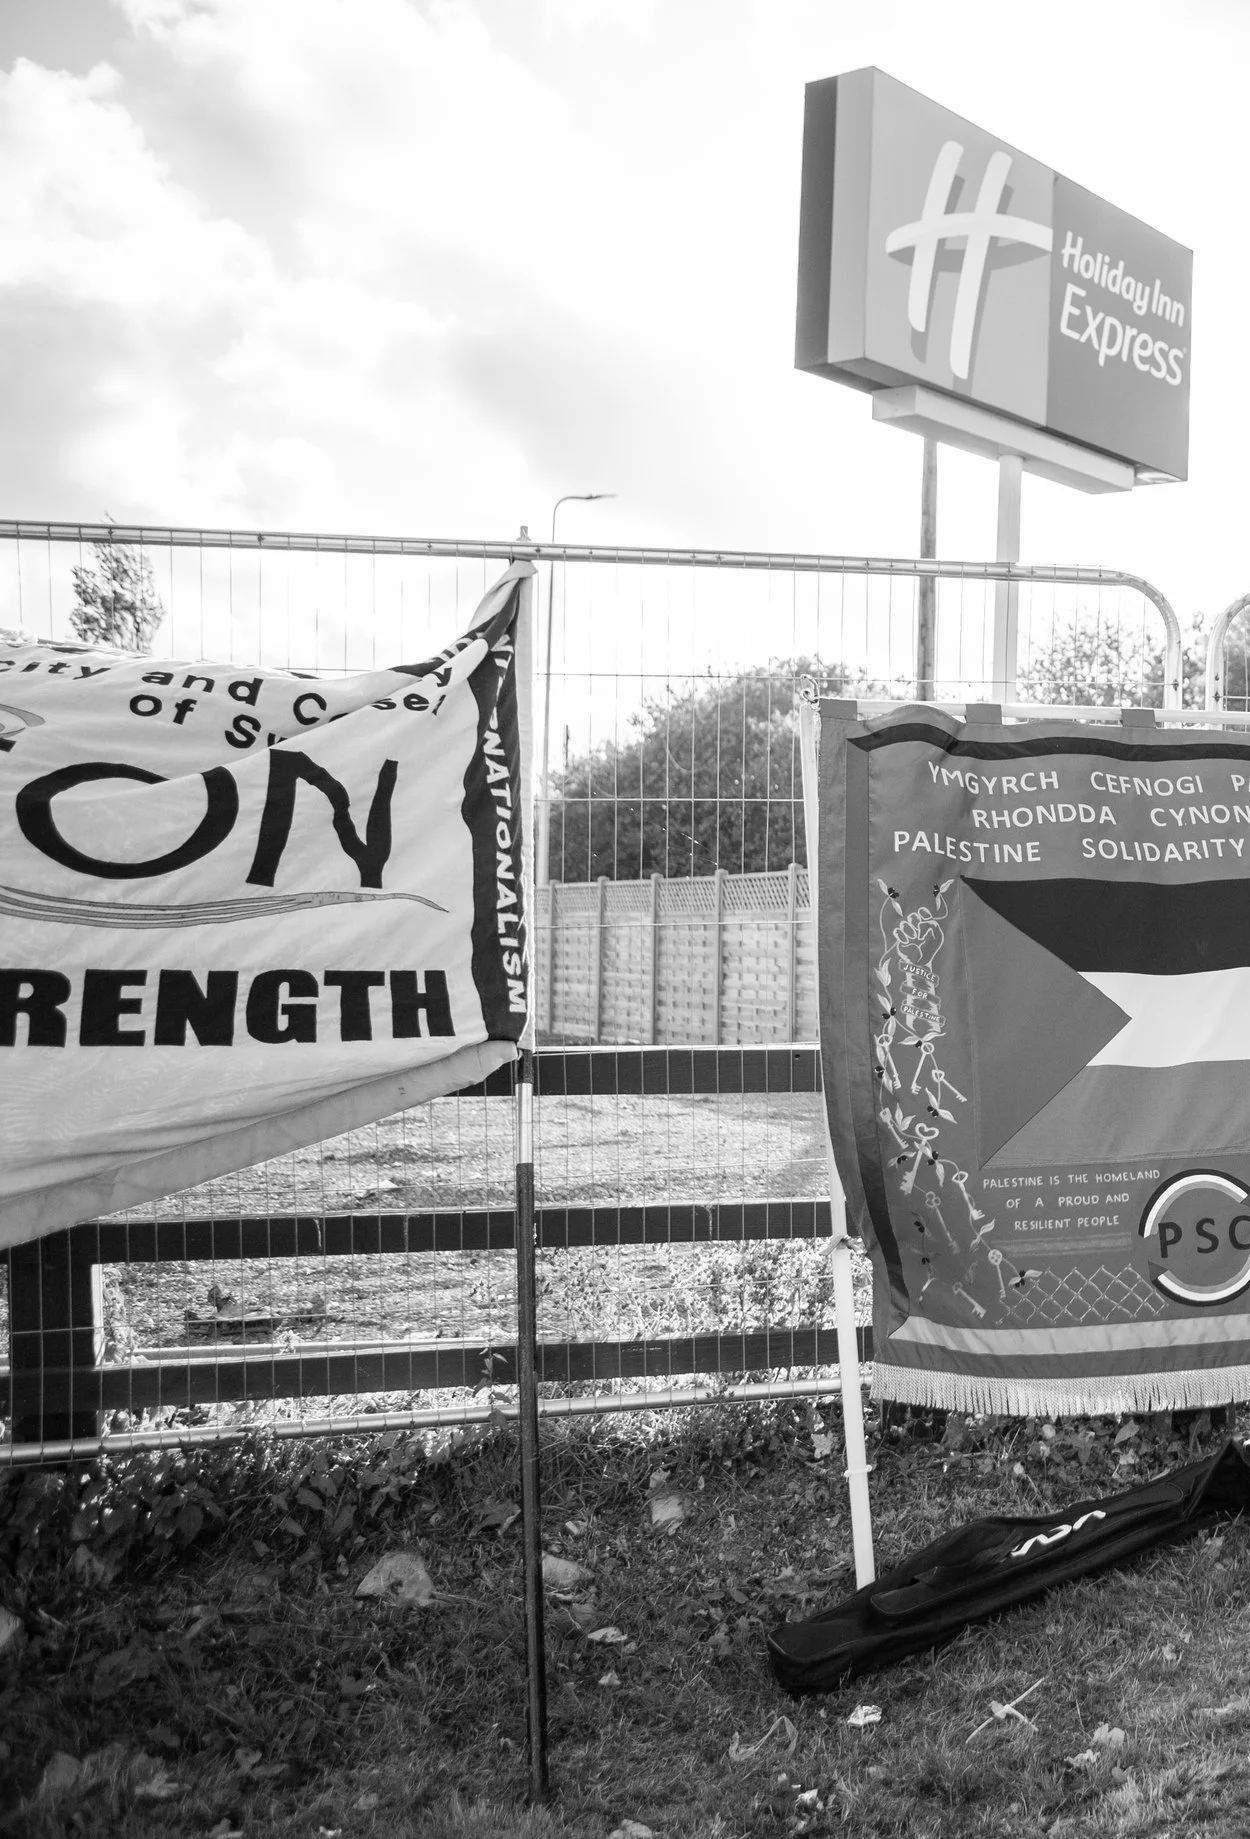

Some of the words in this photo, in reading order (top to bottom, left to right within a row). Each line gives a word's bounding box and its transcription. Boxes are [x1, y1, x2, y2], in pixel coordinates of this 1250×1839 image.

[1061, 231, 1150, 316] Holiday
[1155, 279, 1185, 327] Inn
[1060, 283, 1184, 386] Express
[142, 672, 264, 706] and
[129, 694, 197, 725] of
[928, 761, 1059, 795] YMGYRCH
[1090, 771, 1204, 796] CEFNOGI
[0, 738, 398, 889] ON
[972, 804, 1117, 829] RHONDDA
[894, 831, 1041, 863] PALESTINE
[1082, 838, 1245, 862] SOLIDARITY
[904, 964, 936, 981] JUSTICE
[0, 969, 455, 1048] RENGTH
[912, 988, 927, 999] FOR
[904, 1006, 940, 1022] PALESTINE
[983, 1176, 1044, 1189] PALESTINE
[1050, 1175, 1060, 1186] IS
[1068, 1173, 1088, 1184] THE
[1096, 1169, 1160, 1183] HOMELAND
[1006, 1199, 1022, 1209] OF
[1035, 1197, 1044, 1208] A
[1058, 1195, 1100, 1207] PROUD
[1105, 1193, 1129, 1204] AND
[1014, 1218, 1071, 1231] RESILIENT
[1077, 1216, 1120, 1228] PEOPLE
